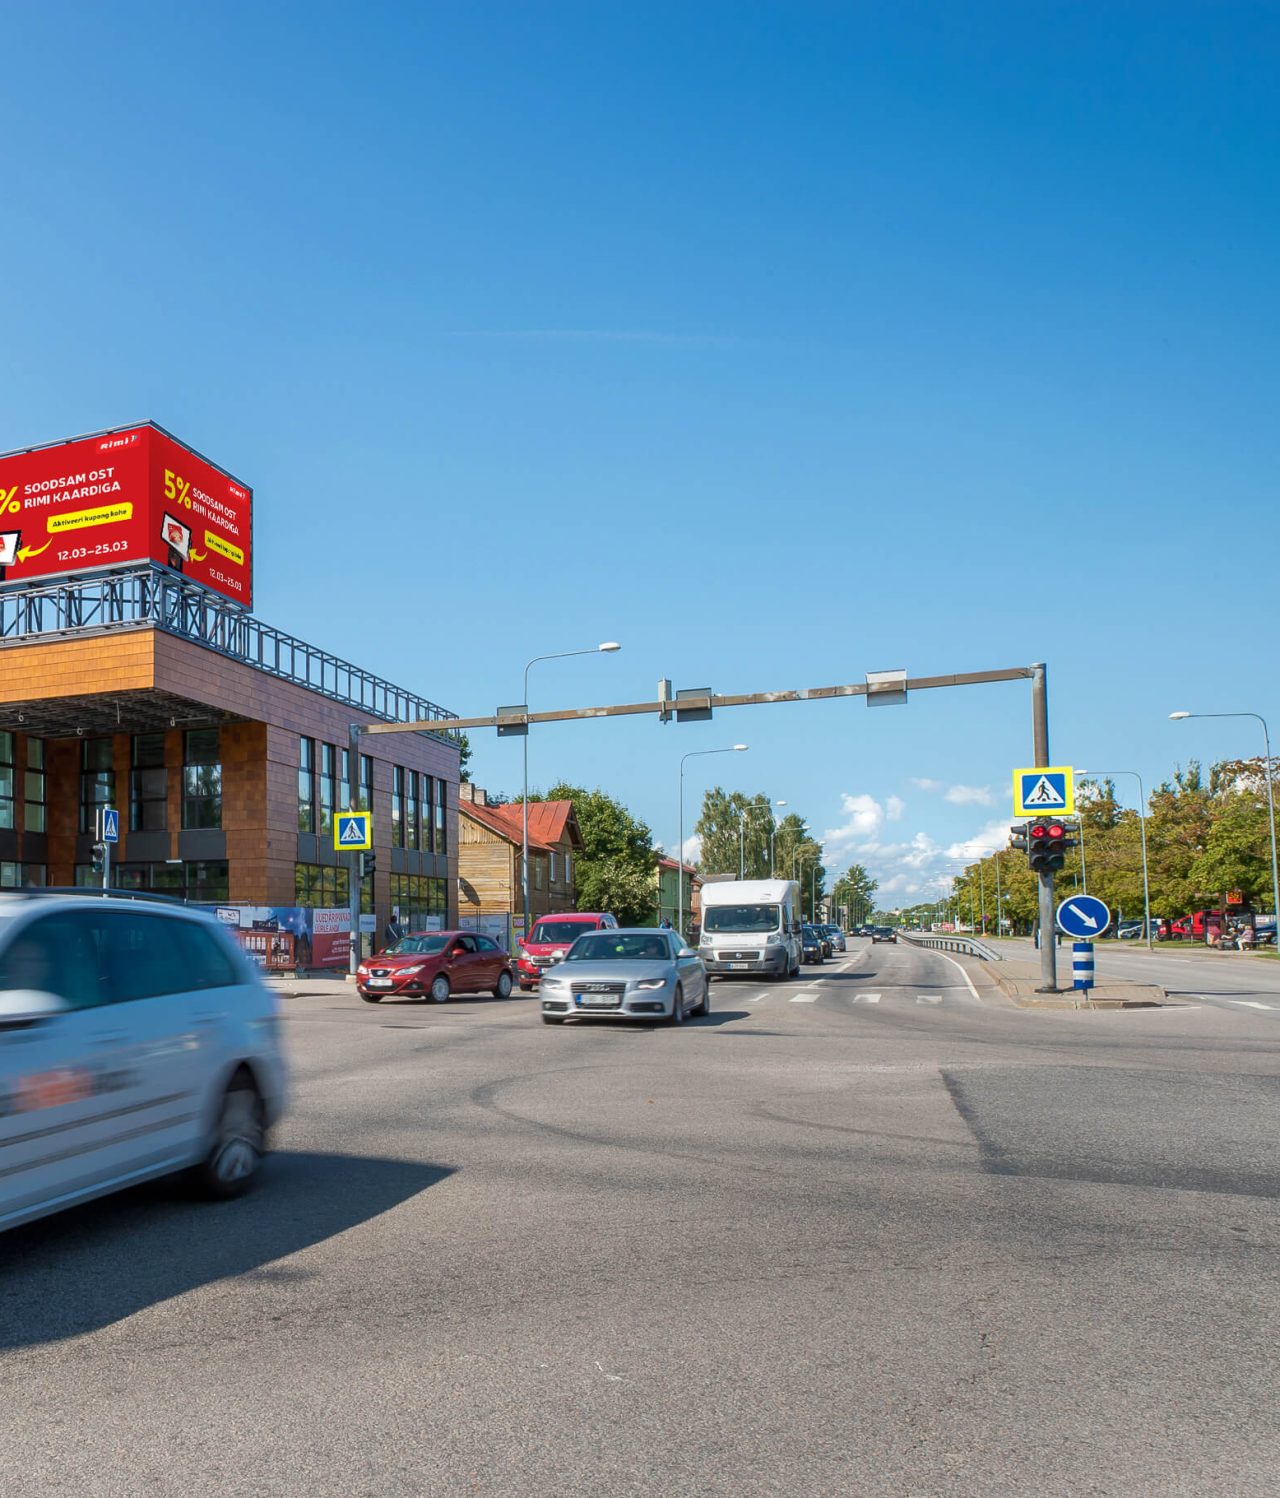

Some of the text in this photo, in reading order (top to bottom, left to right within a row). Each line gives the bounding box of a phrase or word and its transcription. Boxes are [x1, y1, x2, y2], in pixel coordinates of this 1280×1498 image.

[24, 467, 115, 495] SOODSAM OST
[24, 481, 121, 509] RIMI KAARDIGA
[164, 468, 192, 510] 5%
[52, 517, 84, 528] Aktiveeri
[110, 509, 127, 517] kohe
[192, 487, 236, 521] SOODSAM OST
[192, 501, 240, 537] RIMI KAARDIGA
